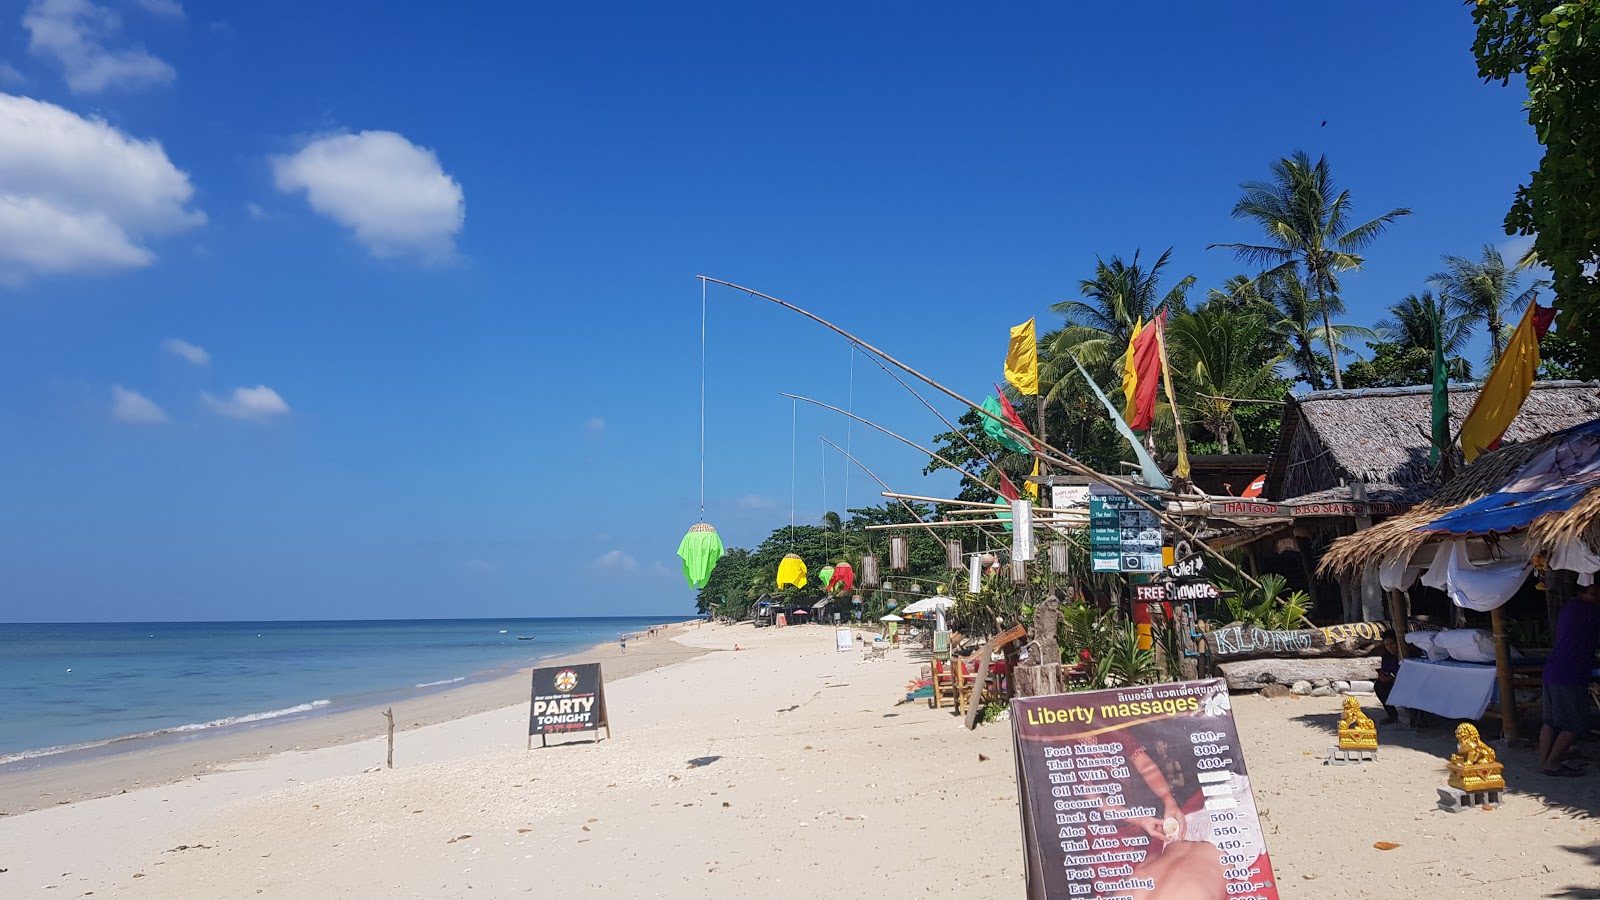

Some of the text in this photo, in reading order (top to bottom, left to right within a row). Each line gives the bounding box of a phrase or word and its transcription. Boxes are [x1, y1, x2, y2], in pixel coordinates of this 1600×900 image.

[1224, 502, 1246, 513] THAI
[1295, 504, 1320, 514] B.B.Q
[1322, 504, 1341, 513] SEA
[1137, 586, 1165, 600] FREE
[1214, 626, 1312, 654] KLONG
[534, 697, 594, 716] PARTY
[1027, 697, 1199, 726] Liberty massages
[537, 713, 591, 725] TONIGHT
[1191, 731, 1225, 743] 300.-
[1044, 743, 1122, 757] Foot Massage
[1194, 744, 1229, 756] 300.-
[1047, 756, 1124, 770] Thai Massage
[1197, 758, 1232, 769] 400.-
[1049, 767, 1130, 783] Thai With Oil
[1052, 784, 1121, 797] Oil Massage
[1055, 795, 1125, 810] Coconut Oil
[1057, 807, 1156, 824] Back & Shoulder
[1210, 812, 1245, 822] 500.-
[1059, 824, 1117, 838] Aloe Vera
[1213, 826, 1248, 836] 550.-
[1061, 836, 1149, 852] Thai Aloe vera
[1217, 840, 1252, 850] 450.-
[1064, 851, 1146, 866] Aromatherapy
[1220, 854, 1256, 864] 300.-
[1066, 865, 1133, 880] Foot Scrub
[1224, 868, 1260, 879] 400.-
[1069, 879, 1154, 894] Ear Candeling
[1227, 882, 1263, 894] 300.-
